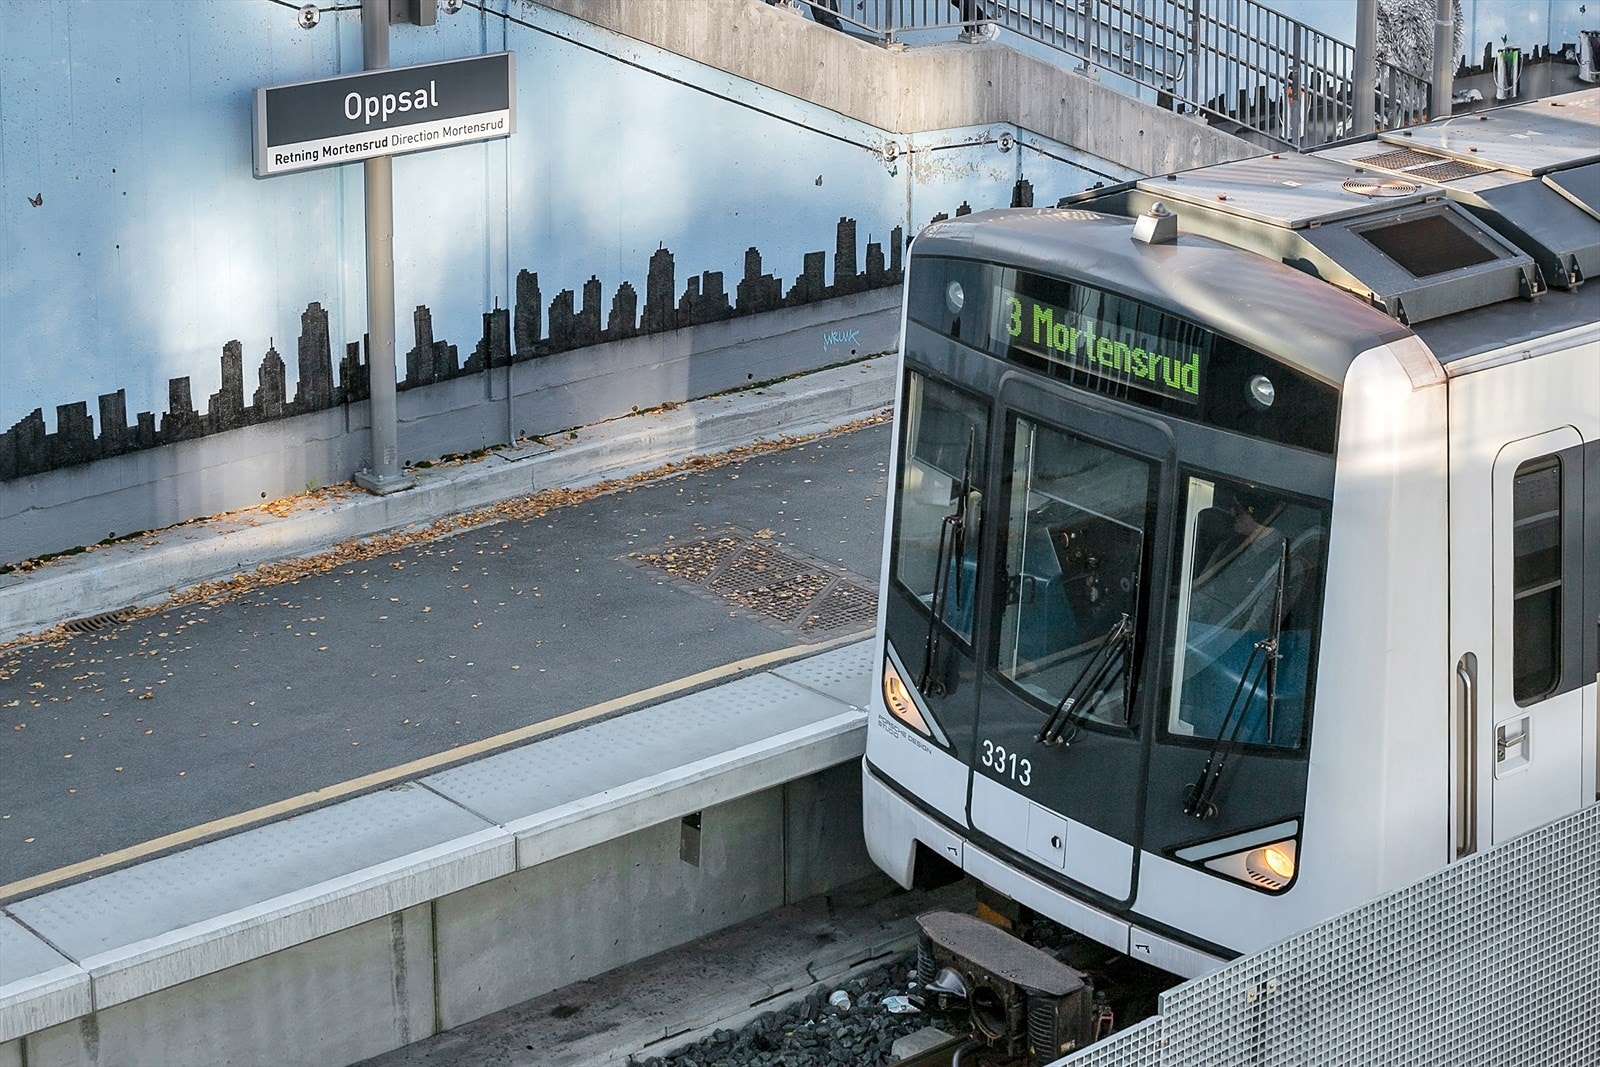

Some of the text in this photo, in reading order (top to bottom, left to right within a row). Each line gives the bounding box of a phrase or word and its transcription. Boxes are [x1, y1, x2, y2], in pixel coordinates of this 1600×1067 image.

[344, 80, 438, 124] Oppsal
[274, 118, 504, 165] Retning Mortensrud Direction Mortensrud
[1006, 297, 1199, 395] 3 Mortensrud
[878, 720, 899, 739] STUDIO
[878, 714, 932, 755] PORSCHE DESIGN
[981, 739, 1032, 786] 3313
